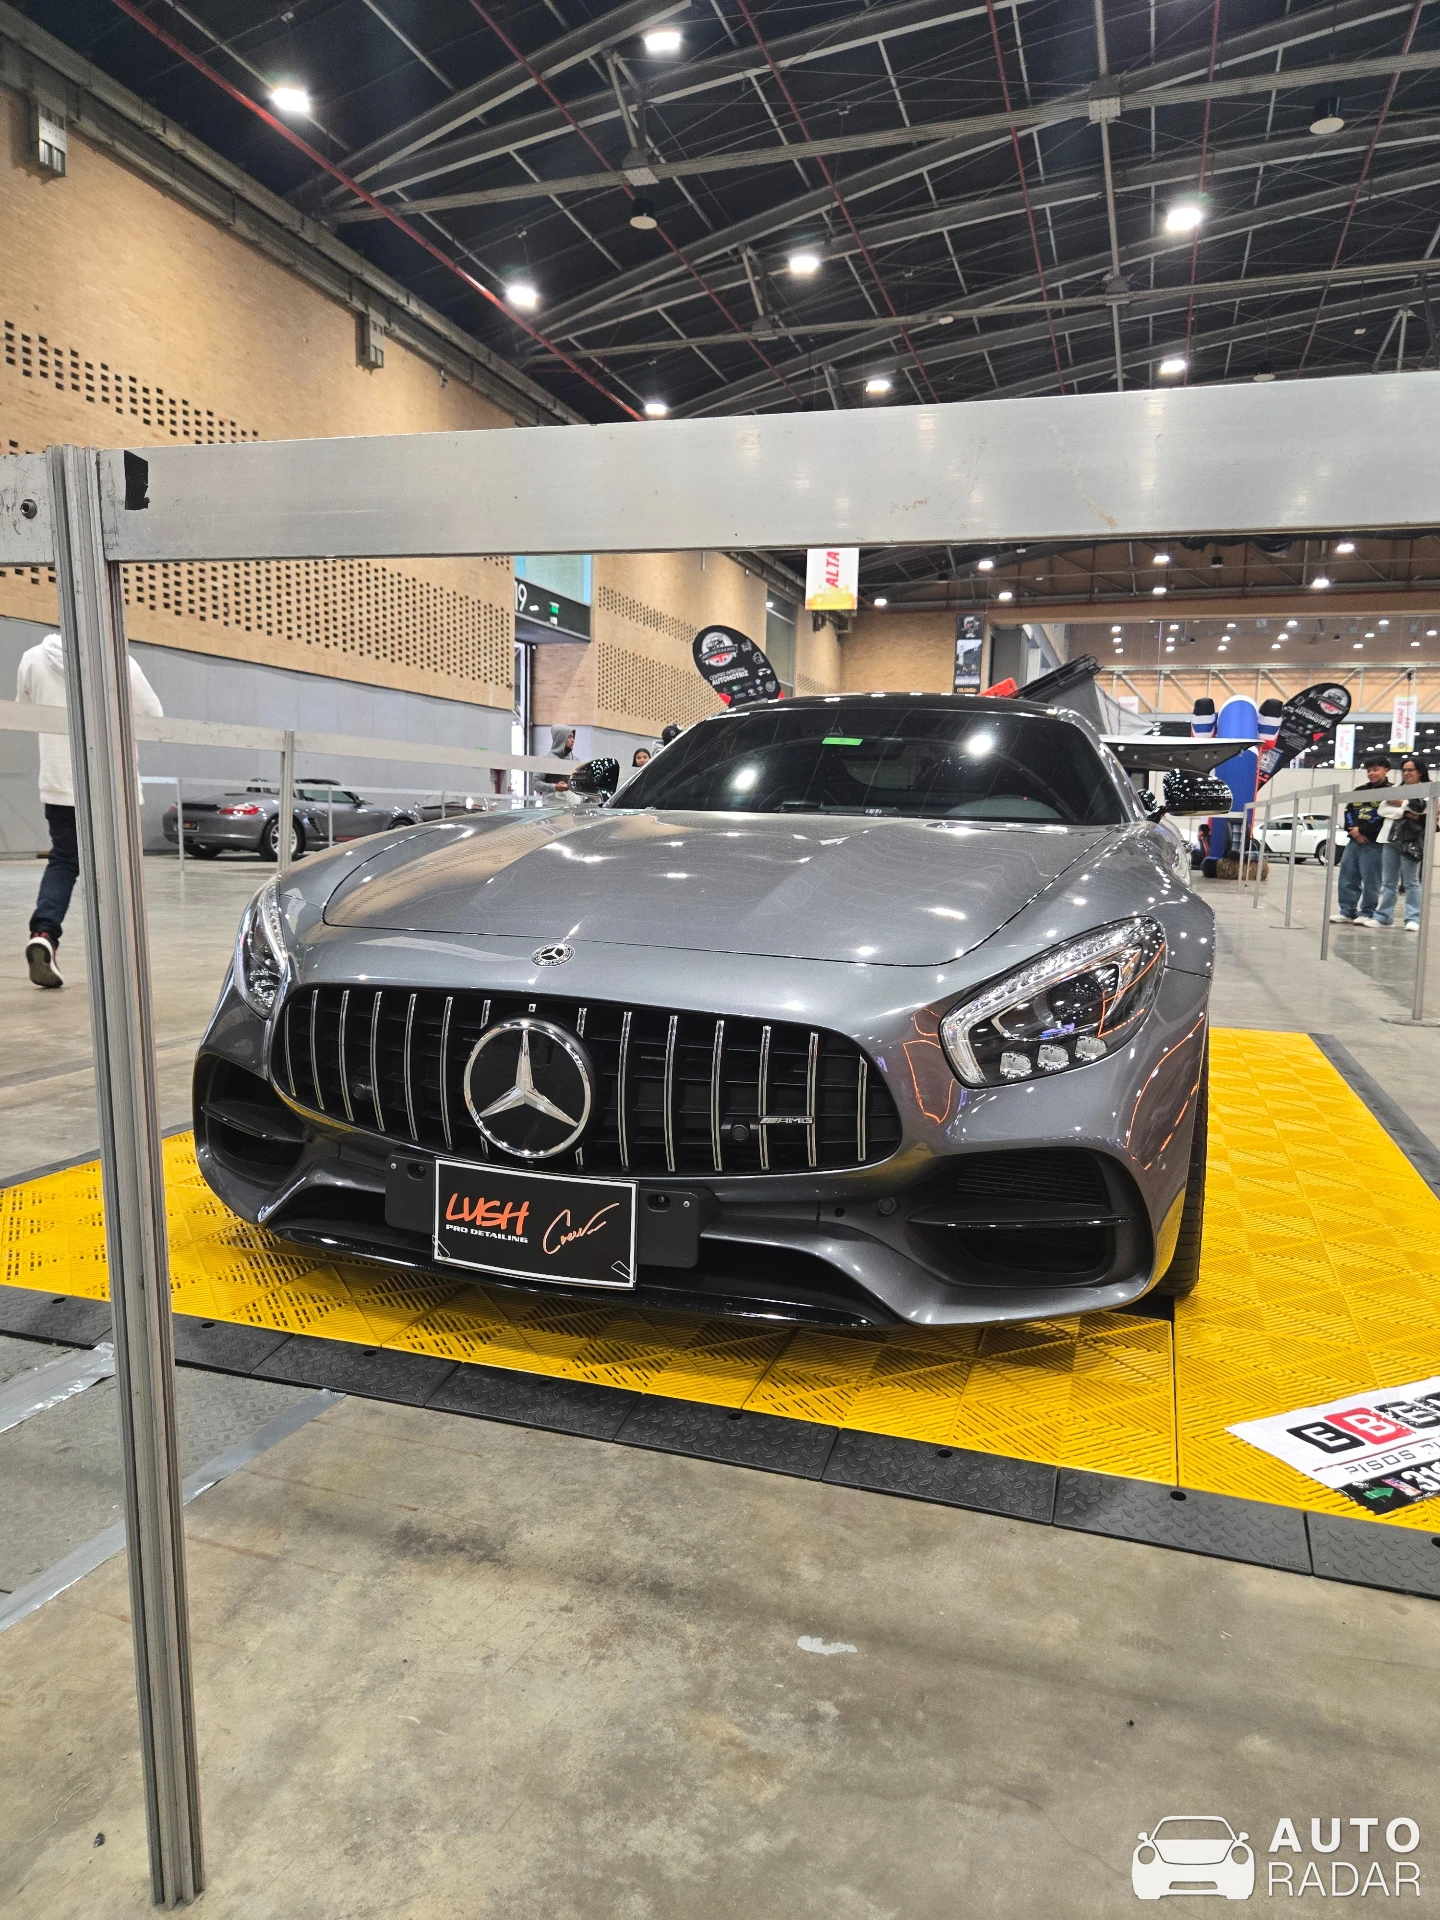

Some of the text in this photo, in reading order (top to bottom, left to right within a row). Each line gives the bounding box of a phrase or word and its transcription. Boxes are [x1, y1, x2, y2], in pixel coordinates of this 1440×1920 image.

[825, 550, 840, 590] ALTA
[711, 669, 750, 686] AUTOMOTRIZ
[445, 1192, 530, 1235] LUSH
[445, 1224, 529, 1244] PRO DETAILING
[1344, 1449, 1417, 1475] PISOS
